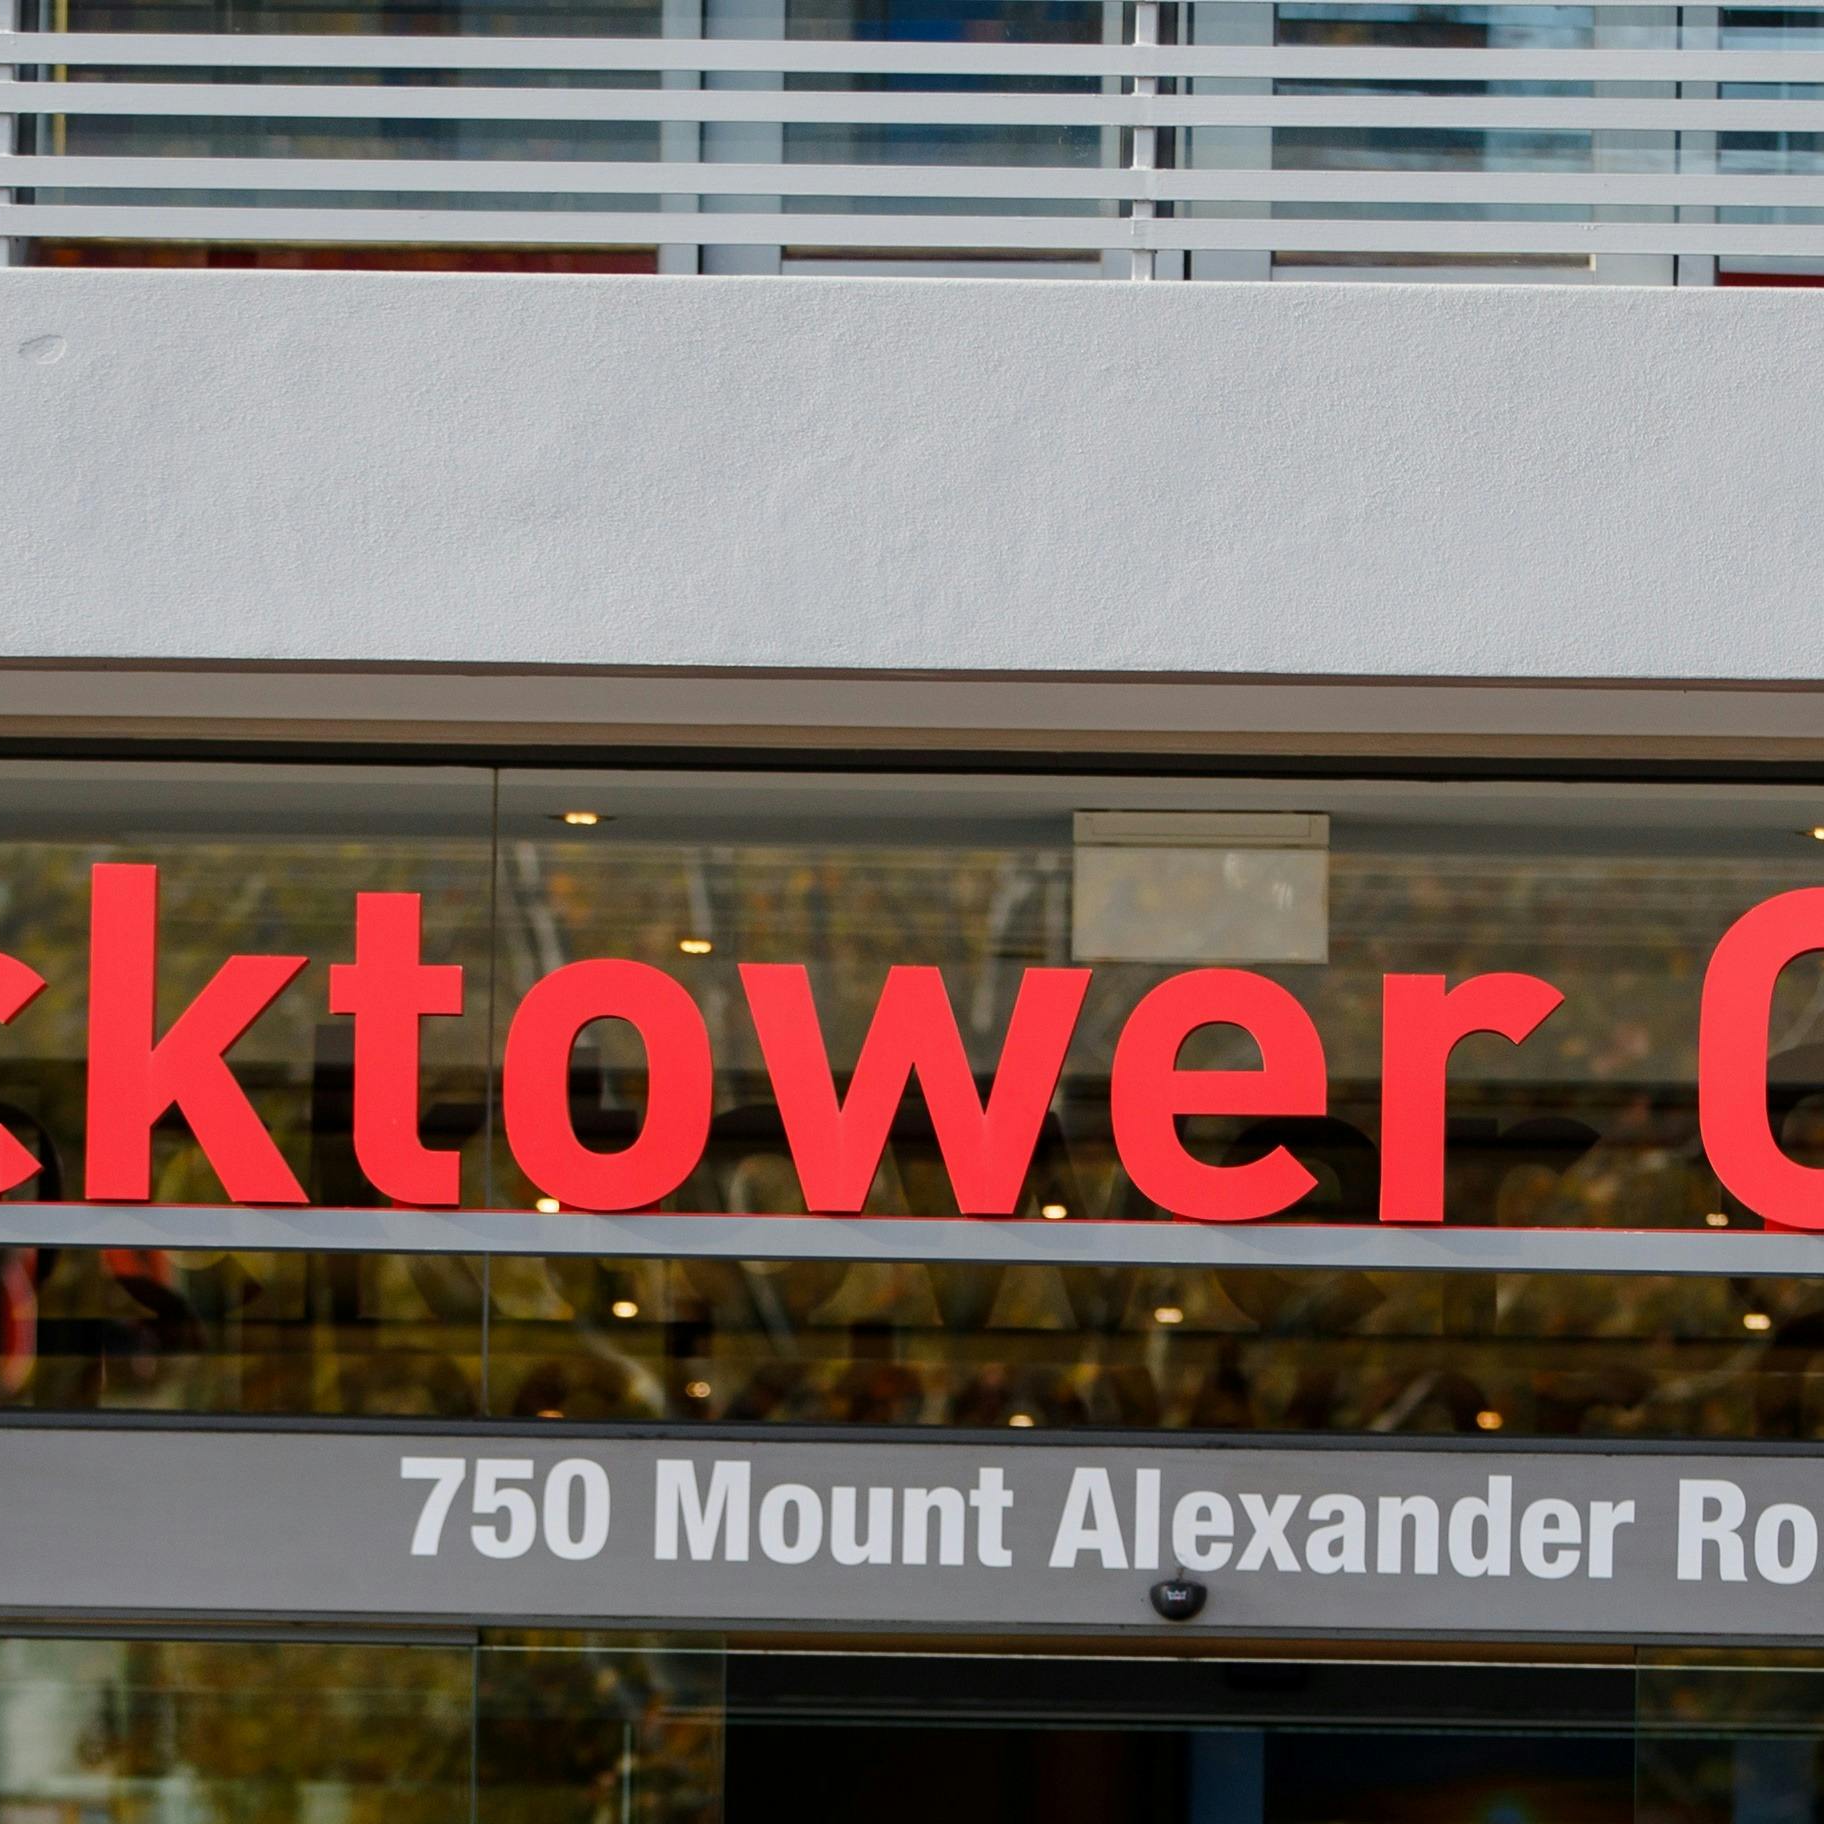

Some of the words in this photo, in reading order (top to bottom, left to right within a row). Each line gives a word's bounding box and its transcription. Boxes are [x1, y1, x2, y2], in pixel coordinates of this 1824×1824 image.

[400, 1457, 610, 1560] 750
[655, 1459, 1013, 1567] Mount
[1049, 1467, 1635, 1578] Alexander
